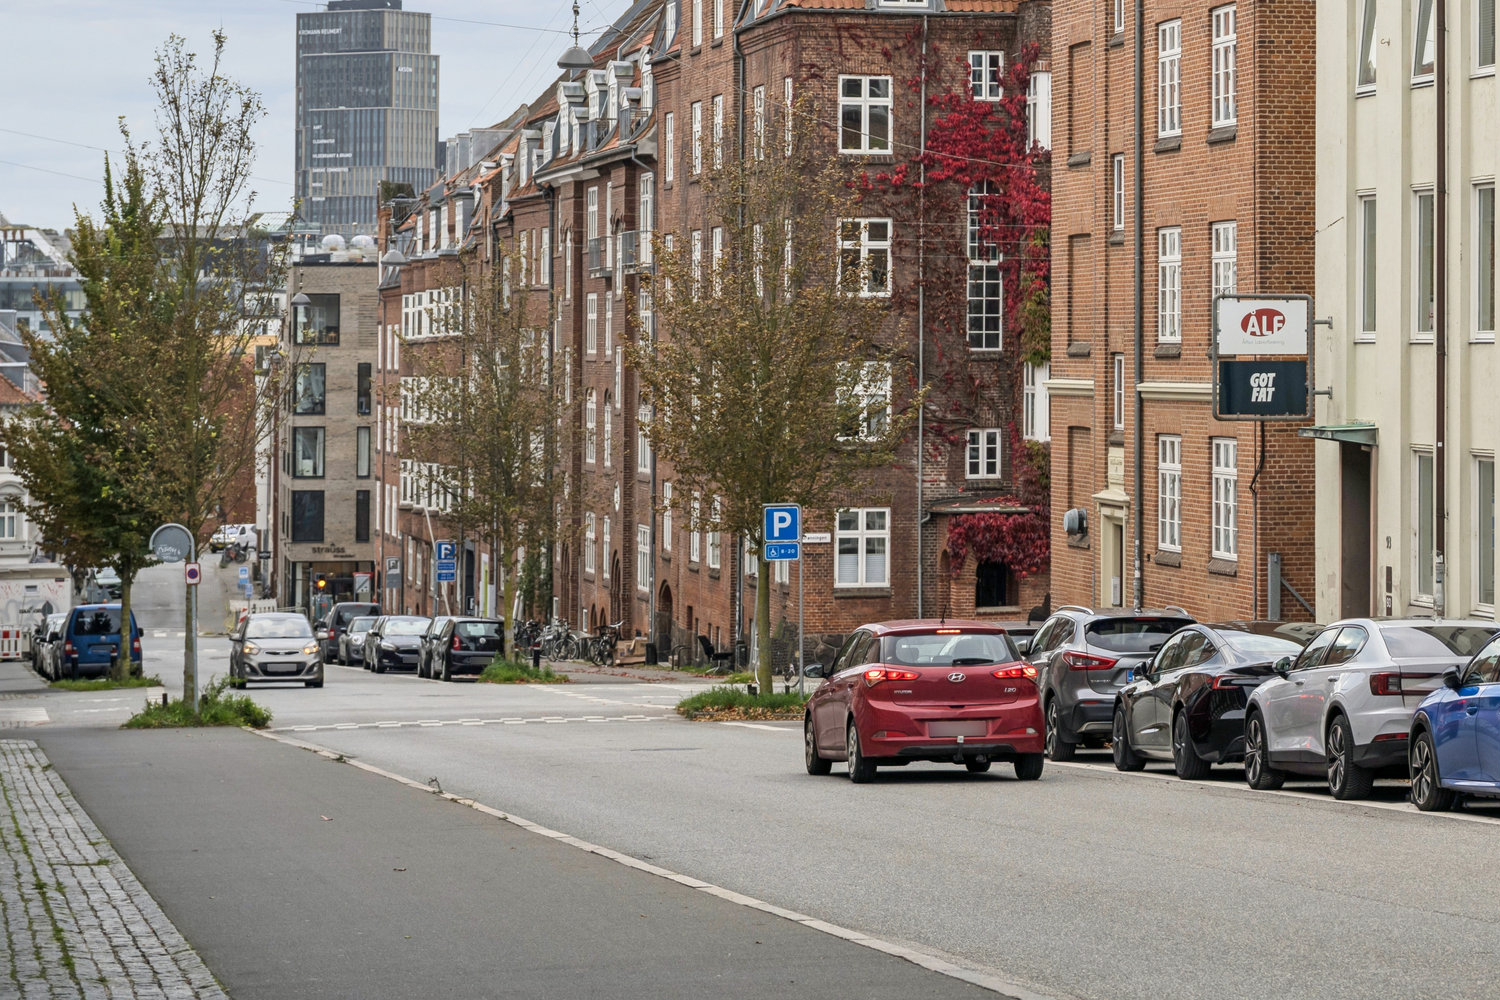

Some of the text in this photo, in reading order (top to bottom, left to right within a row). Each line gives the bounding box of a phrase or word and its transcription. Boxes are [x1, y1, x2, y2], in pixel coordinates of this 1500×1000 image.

[1246, 310, 1285, 336] ÅLF
[1250, 372, 1276, 388] GOT
[1251, 387, 1275, 402] FAT
[773, 511, 792, 537] P
